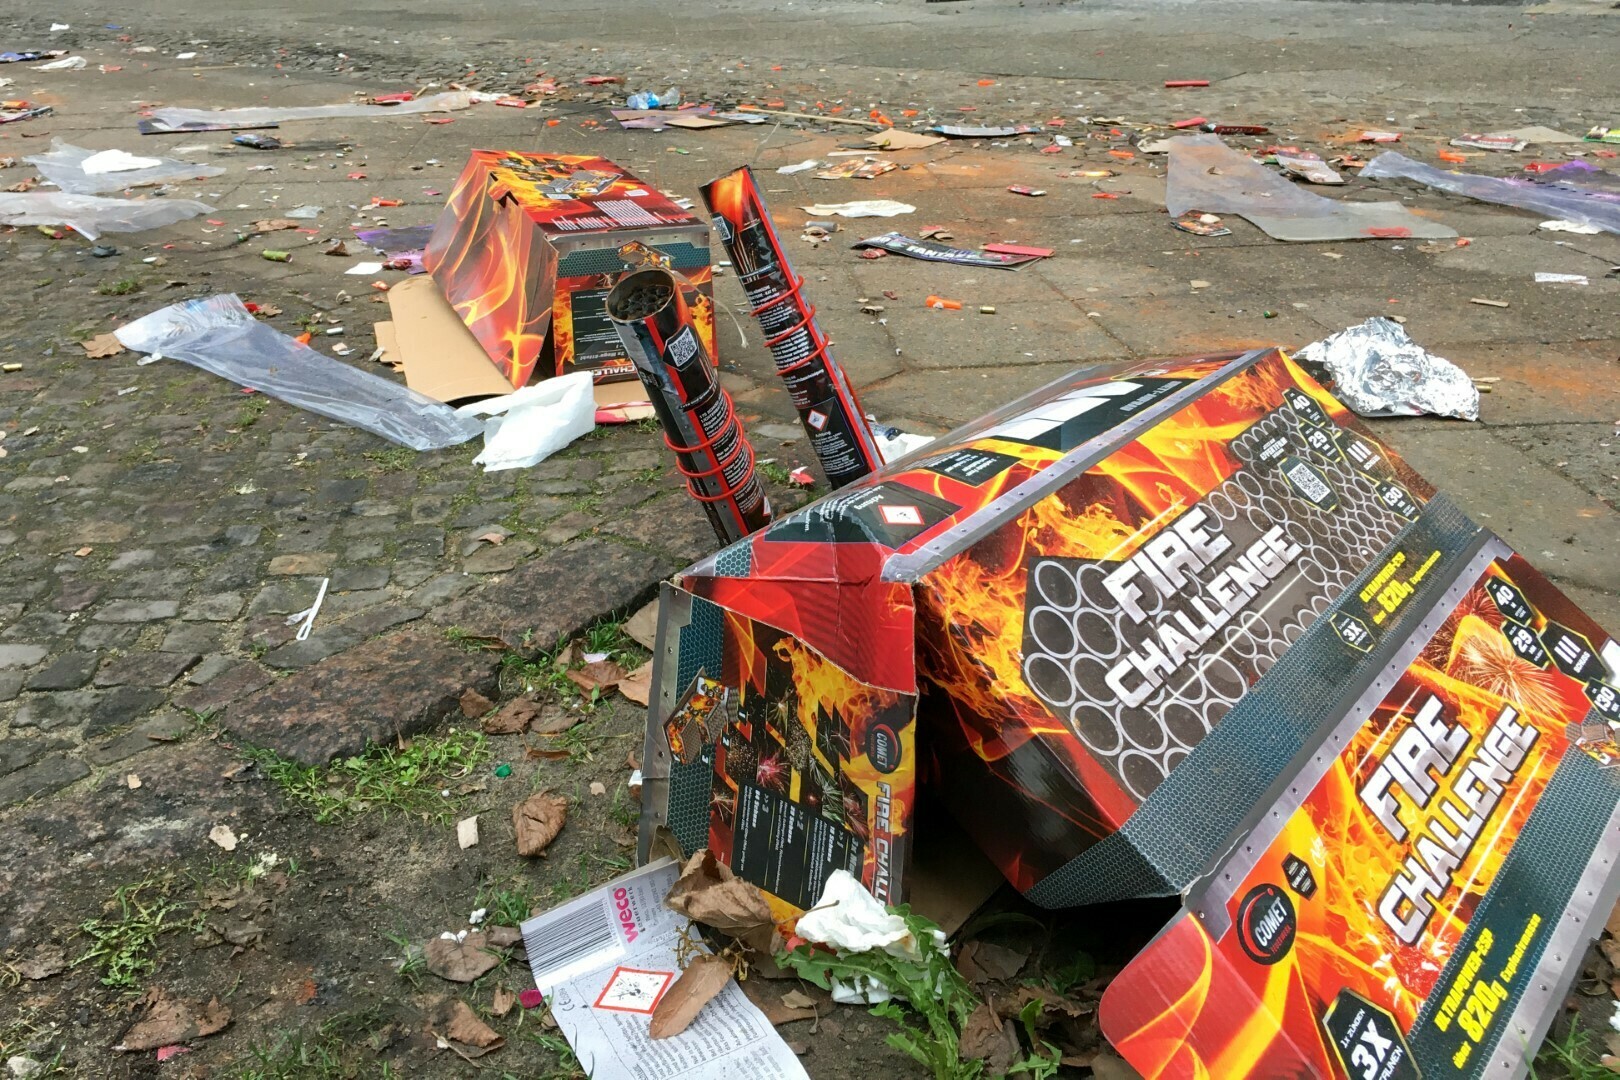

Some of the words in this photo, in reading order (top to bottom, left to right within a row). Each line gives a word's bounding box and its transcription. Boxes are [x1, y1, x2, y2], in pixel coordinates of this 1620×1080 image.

[1292, 393, 1311, 410] 40
[1307, 429, 1328, 449] 29
[1382, 485, 1403, 506] 130
[1100, 505, 1234, 625] FIRE
[1495, 583, 1515, 605] 40
[1102, 523, 1304, 709] CHALLENGE
[1341, 620, 1363, 642] 3X
[1511, 627, 1534, 653] 29
[1572, 650, 1591, 673] SCHUSS
[1593, 685, 1616, 712] 130
[722, 736, 729, 746] 2
[876, 732, 887, 768] COMET
[701, 754, 708, 764] 3
[1358, 693, 1471, 842] FIRE
[876, 780, 890, 832] FIRE
[1376, 703, 1539, 943] CHALLENGE
[612, 886, 638, 943] weco
[1252, 895, 1289, 947] COMET
[1433, 926, 1496, 1032] ULTRAPOWER-ESP
[1454, 978, 1510, 1043] 820g
[1499, 912, 1542, 982] Explosivmasse
[1344, 1008, 1366, 1038] ZÜNDEN
[1347, 1017, 1393, 1080] 3X
